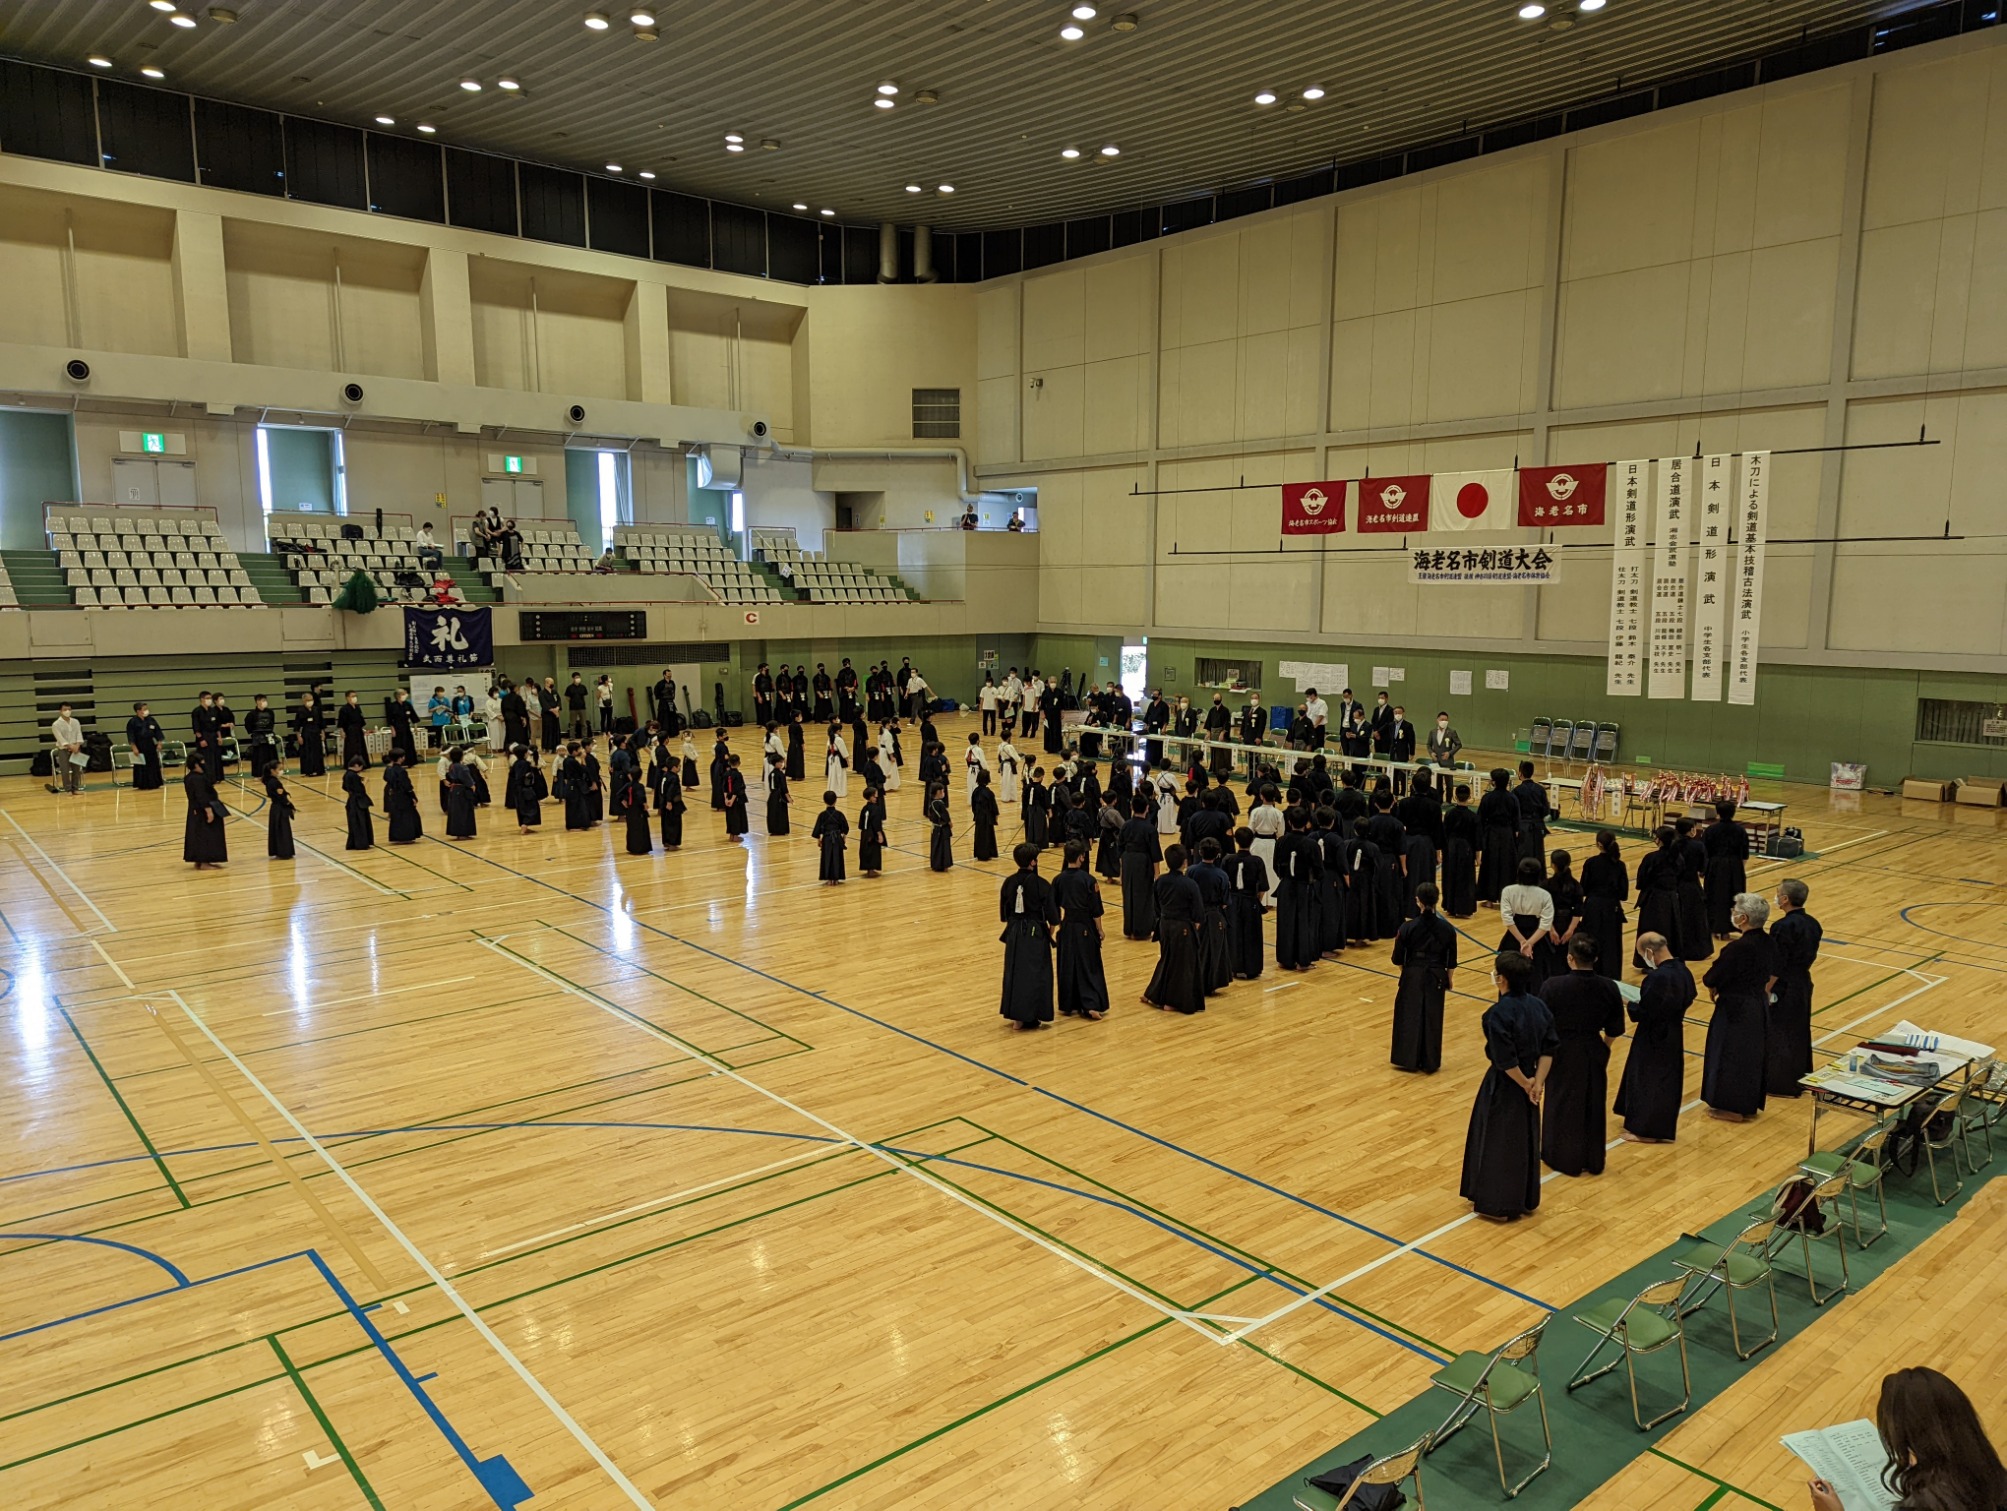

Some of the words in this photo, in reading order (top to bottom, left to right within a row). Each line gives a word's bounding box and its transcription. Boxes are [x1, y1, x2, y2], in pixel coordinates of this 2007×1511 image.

[1534, 503, 1588, 517] 海老名市
[1624, 464, 1637, 547] 日本剣道形演武
[1669, 459, 1681, 520] 居合道演武
[1703, 457, 1720, 605] 日本剣道形演武
[1741, 455, 1761, 620] 木刀による剣道基本技稽古法演武
[1413, 548, 1553, 571] 海老名市剣道大会
[430, 615, 469, 652] 礼
[746, 612, 757, 623] C
